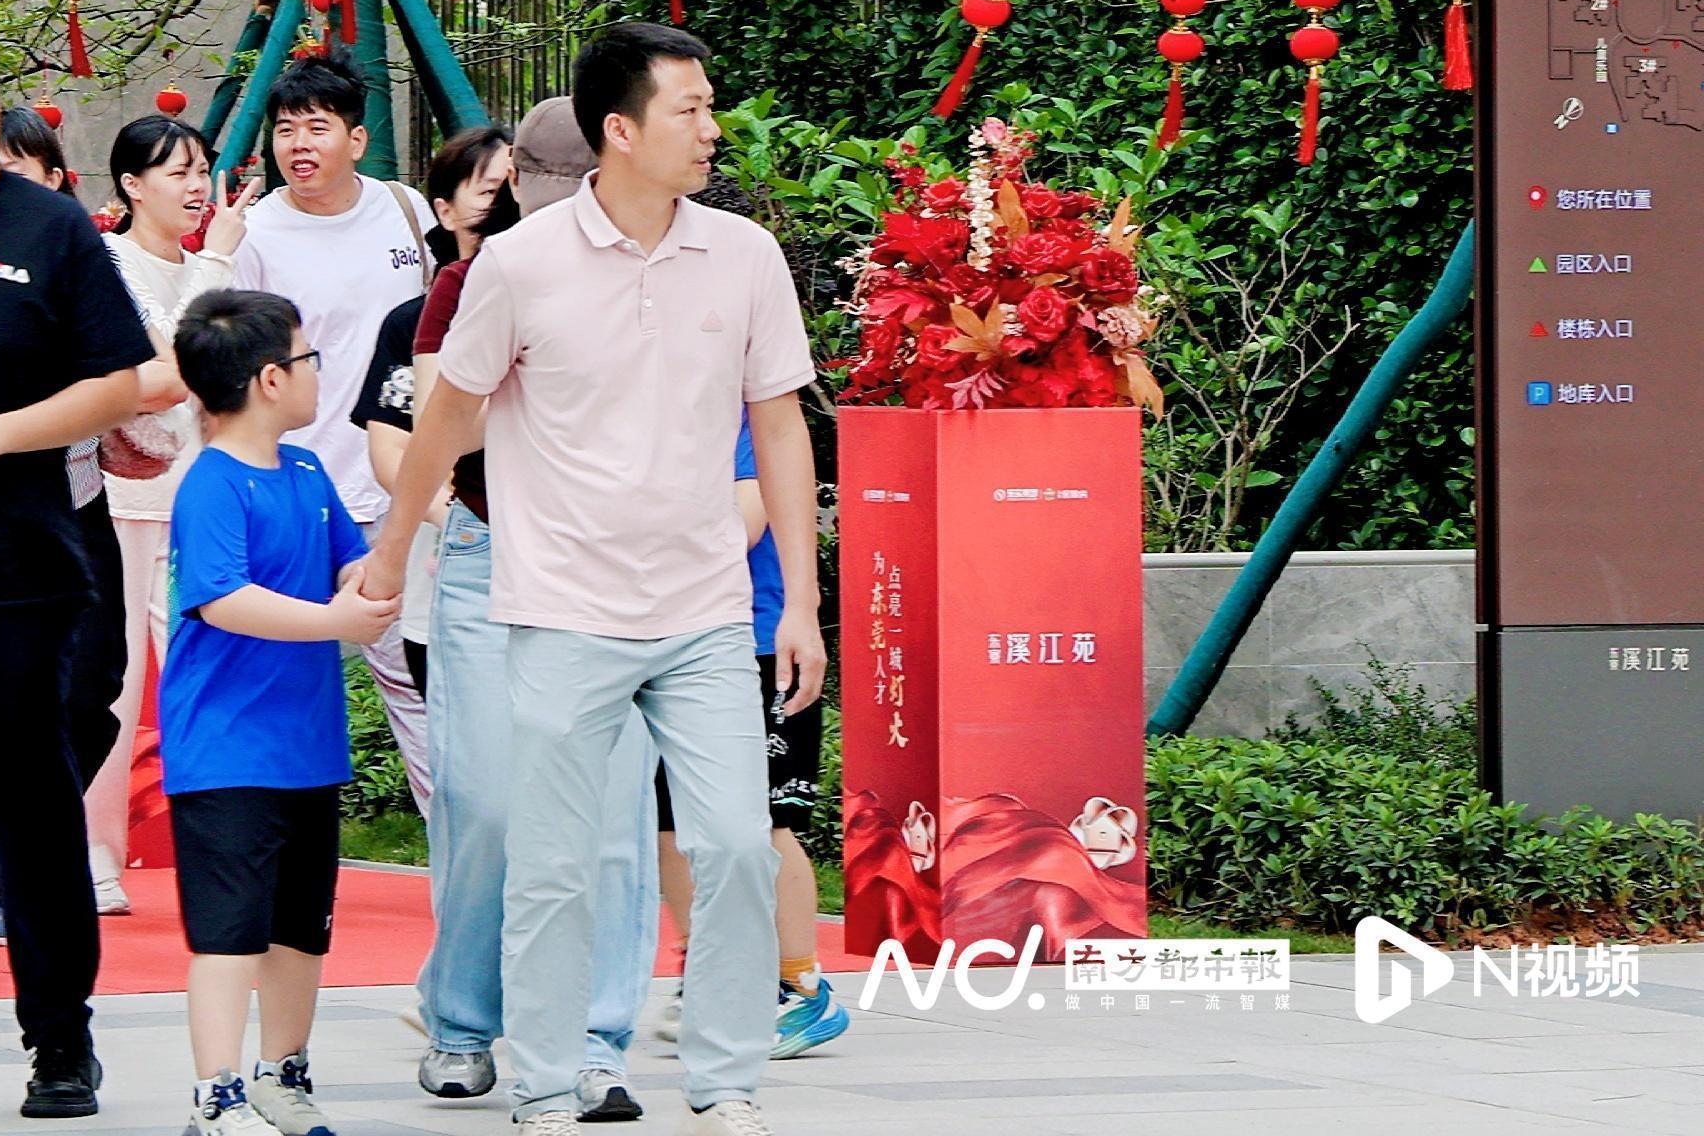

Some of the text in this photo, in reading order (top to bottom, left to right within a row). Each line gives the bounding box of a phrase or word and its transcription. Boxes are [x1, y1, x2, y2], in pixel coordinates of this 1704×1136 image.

[1556, 189, 1652, 210] 您所在位置
[1556, 254, 1632, 274] 园区入口
[1557, 319, 1633, 339] 楼栋入口
[1558, 384, 1634, 403] 地库入口
